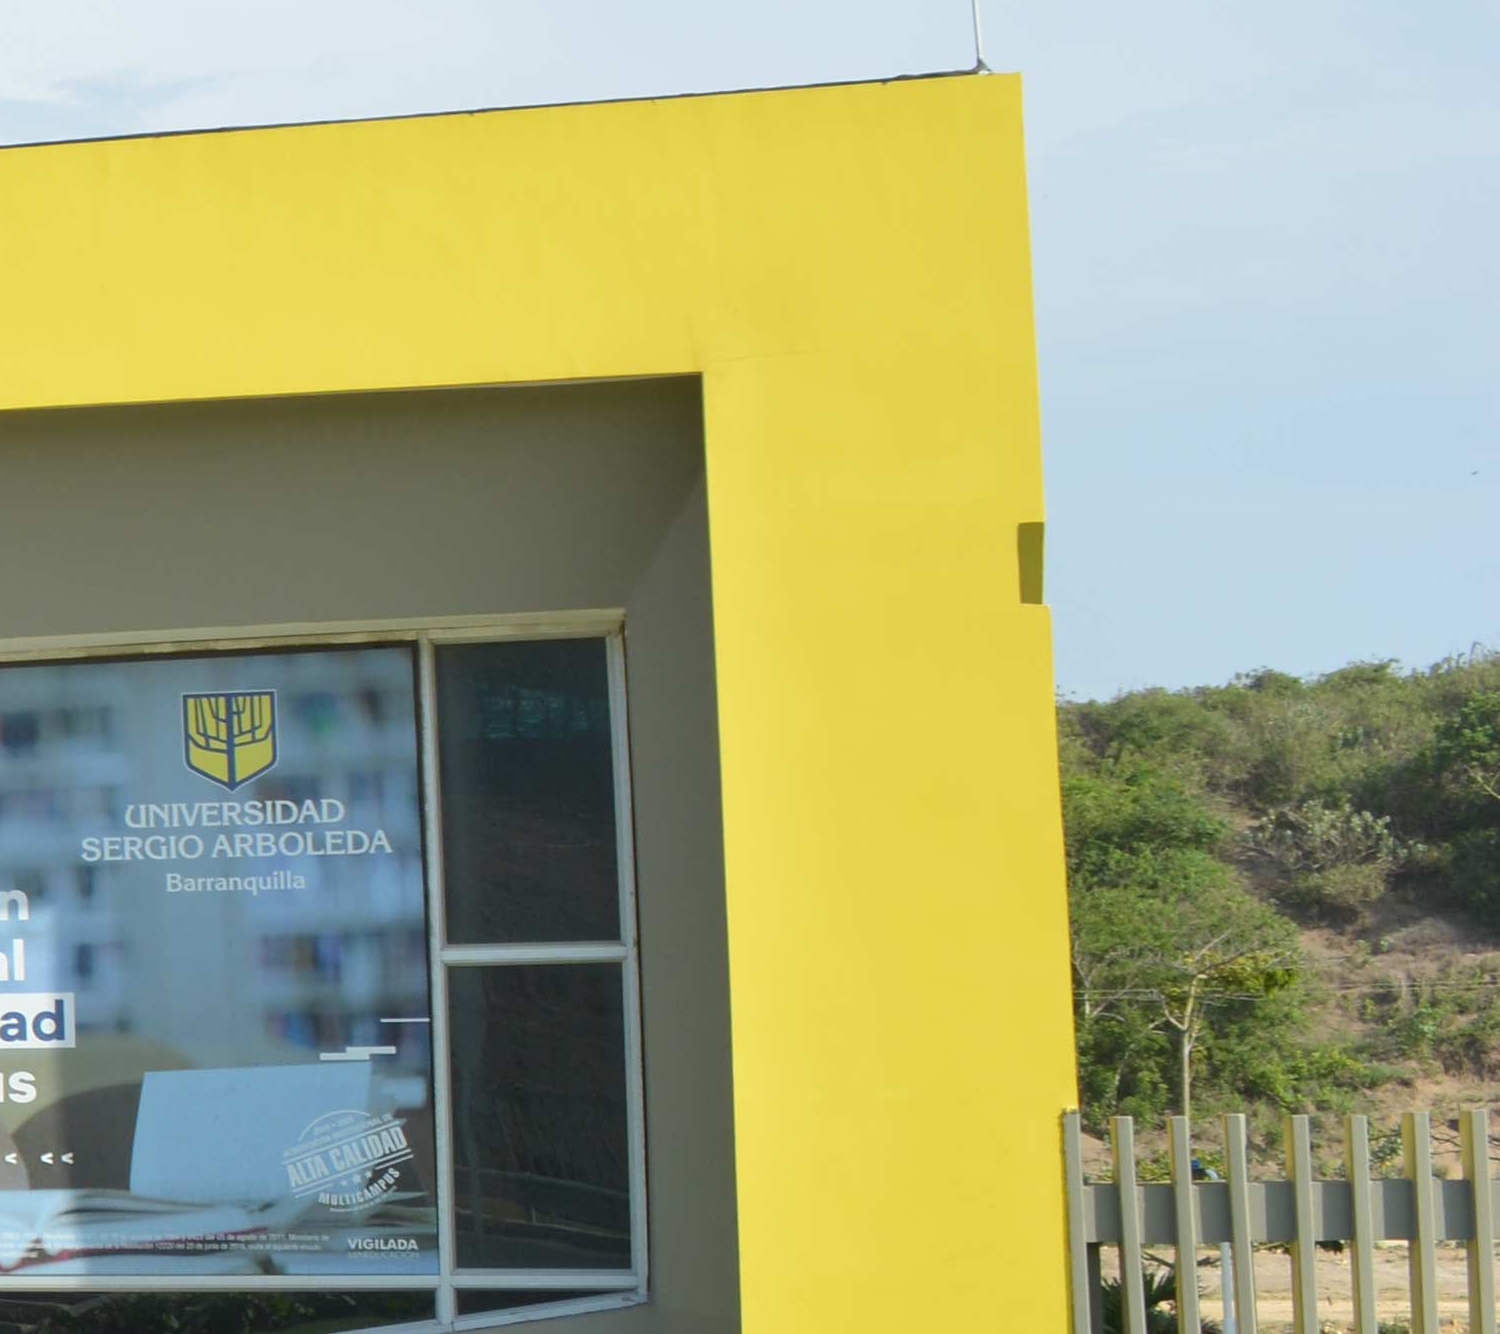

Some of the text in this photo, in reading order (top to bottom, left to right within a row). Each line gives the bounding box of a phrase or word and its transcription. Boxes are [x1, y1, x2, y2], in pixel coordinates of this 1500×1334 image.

[125, 798, 345, 829] UNIVERSIDAD
[81, 829, 393, 862] SERGIO ARBOLEDA
[165, 870, 306, 896] Barranquilla
[287, 1156, 328, 1187] ALTA
[329, 1127, 407, 1170] CALIDAD
[319, 1168, 400, 1206] MULTICAMPUS
[348, 1238, 418, 1250] VIGILADA
